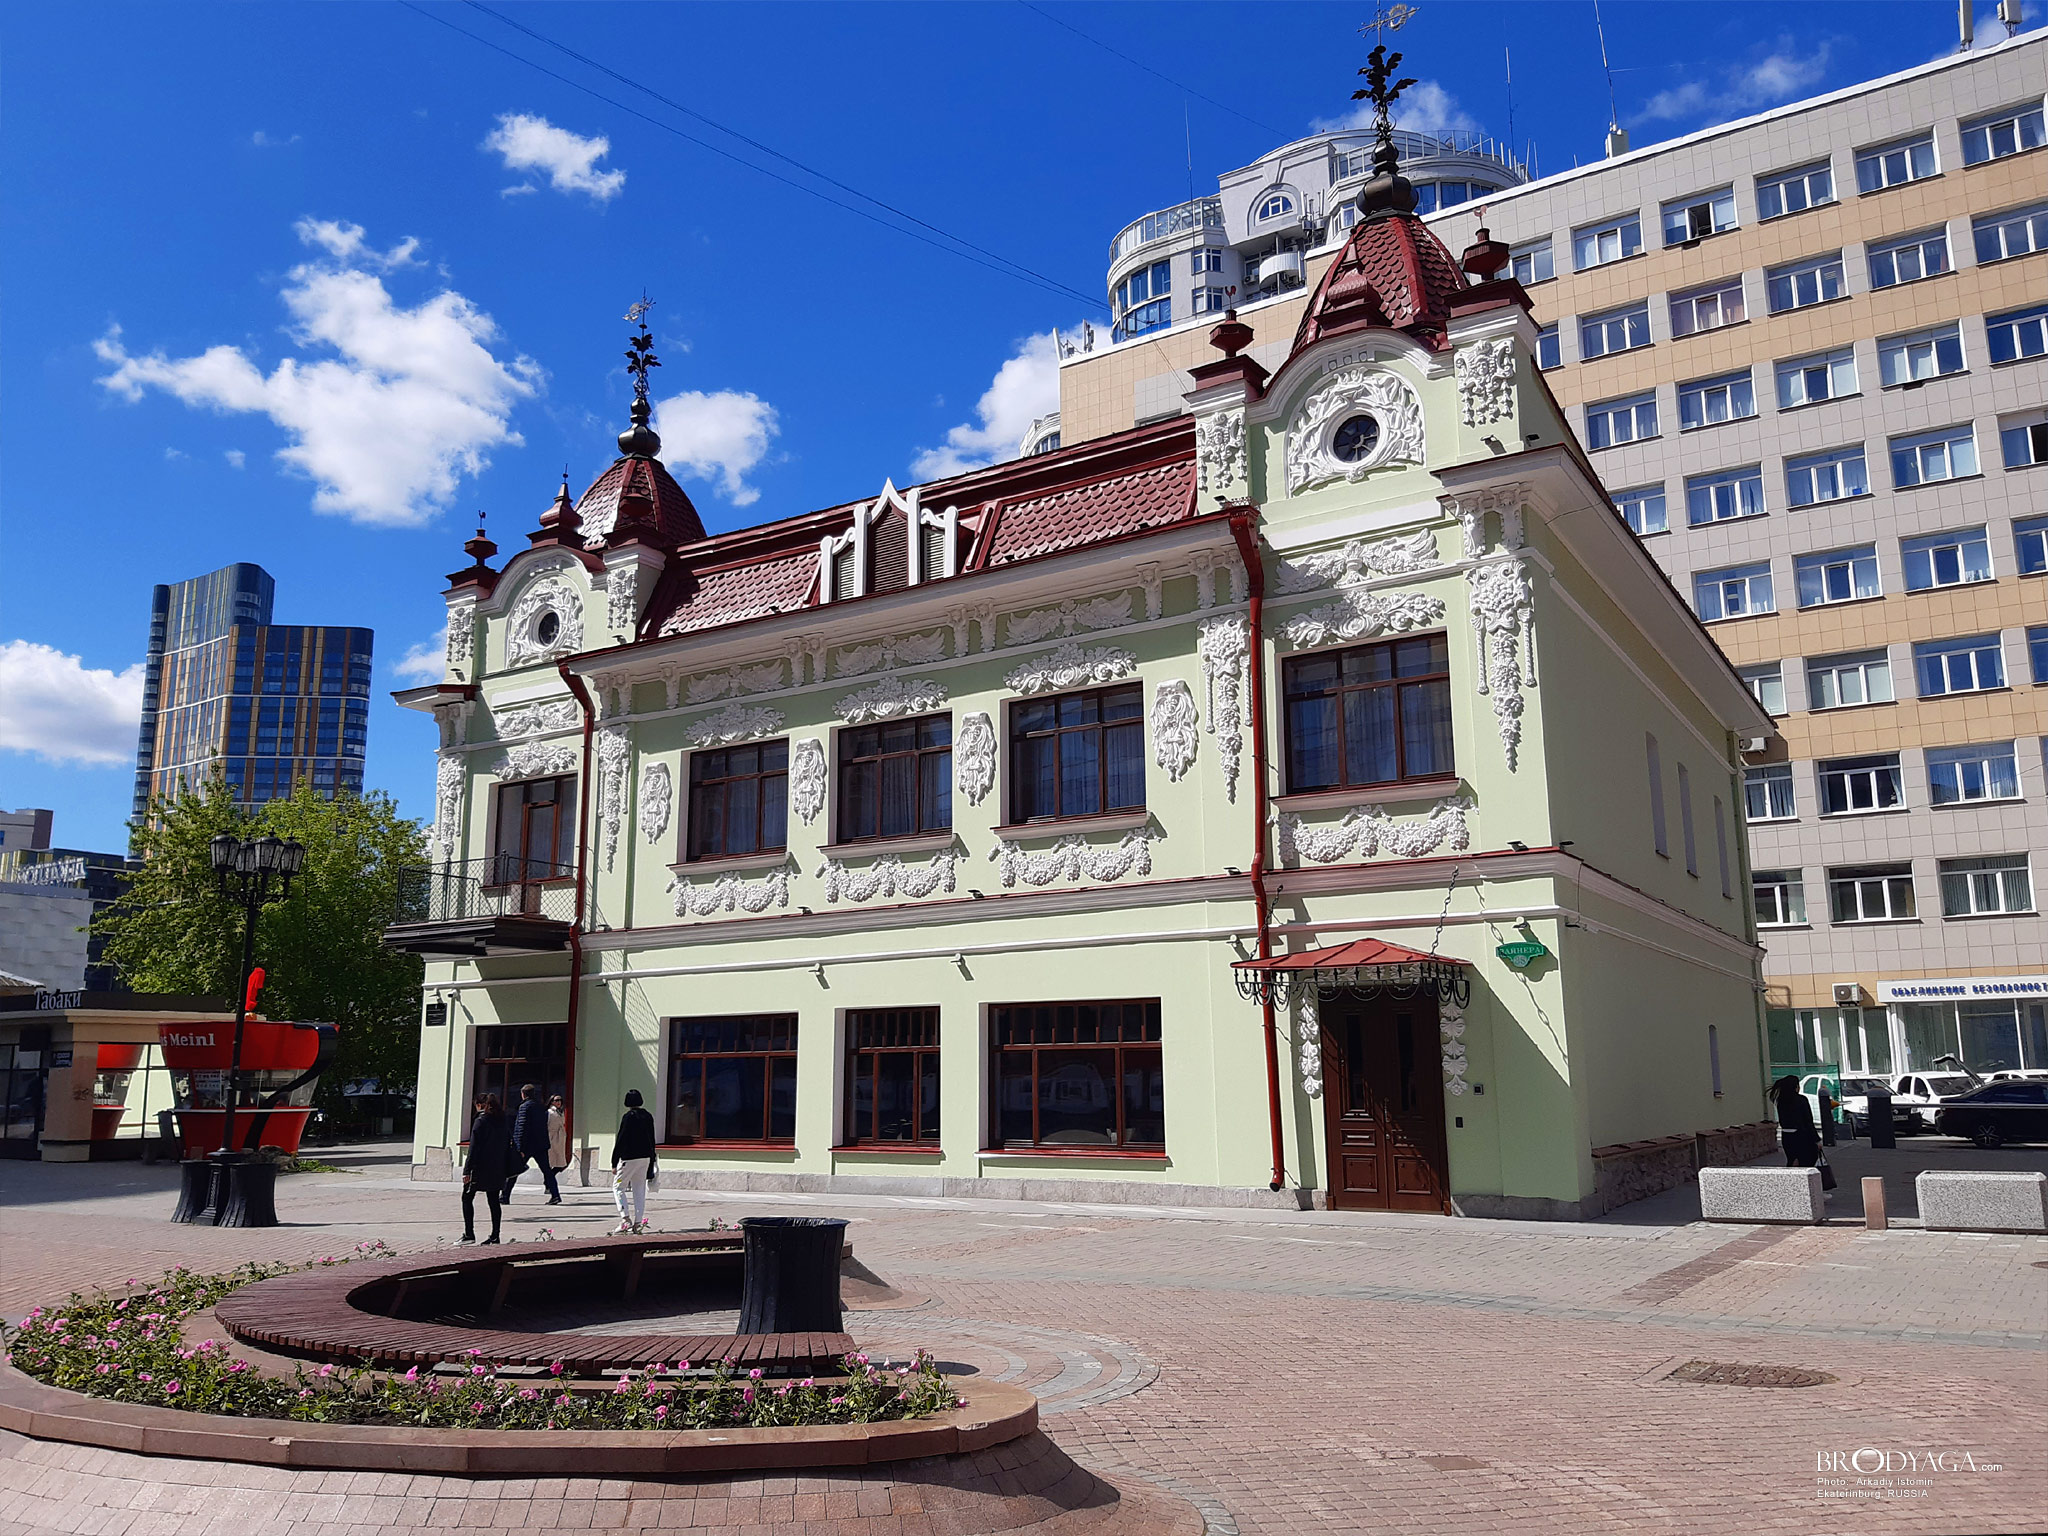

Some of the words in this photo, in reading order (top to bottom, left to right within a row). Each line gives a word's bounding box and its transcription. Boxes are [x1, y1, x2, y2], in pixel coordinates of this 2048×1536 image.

[1891, 985, 1967, 997] ОБЪЕДИНЕНИЕ
[34, 988, 82, 1010] Табаки
[169, 1033, 216, 1047] Meinl
